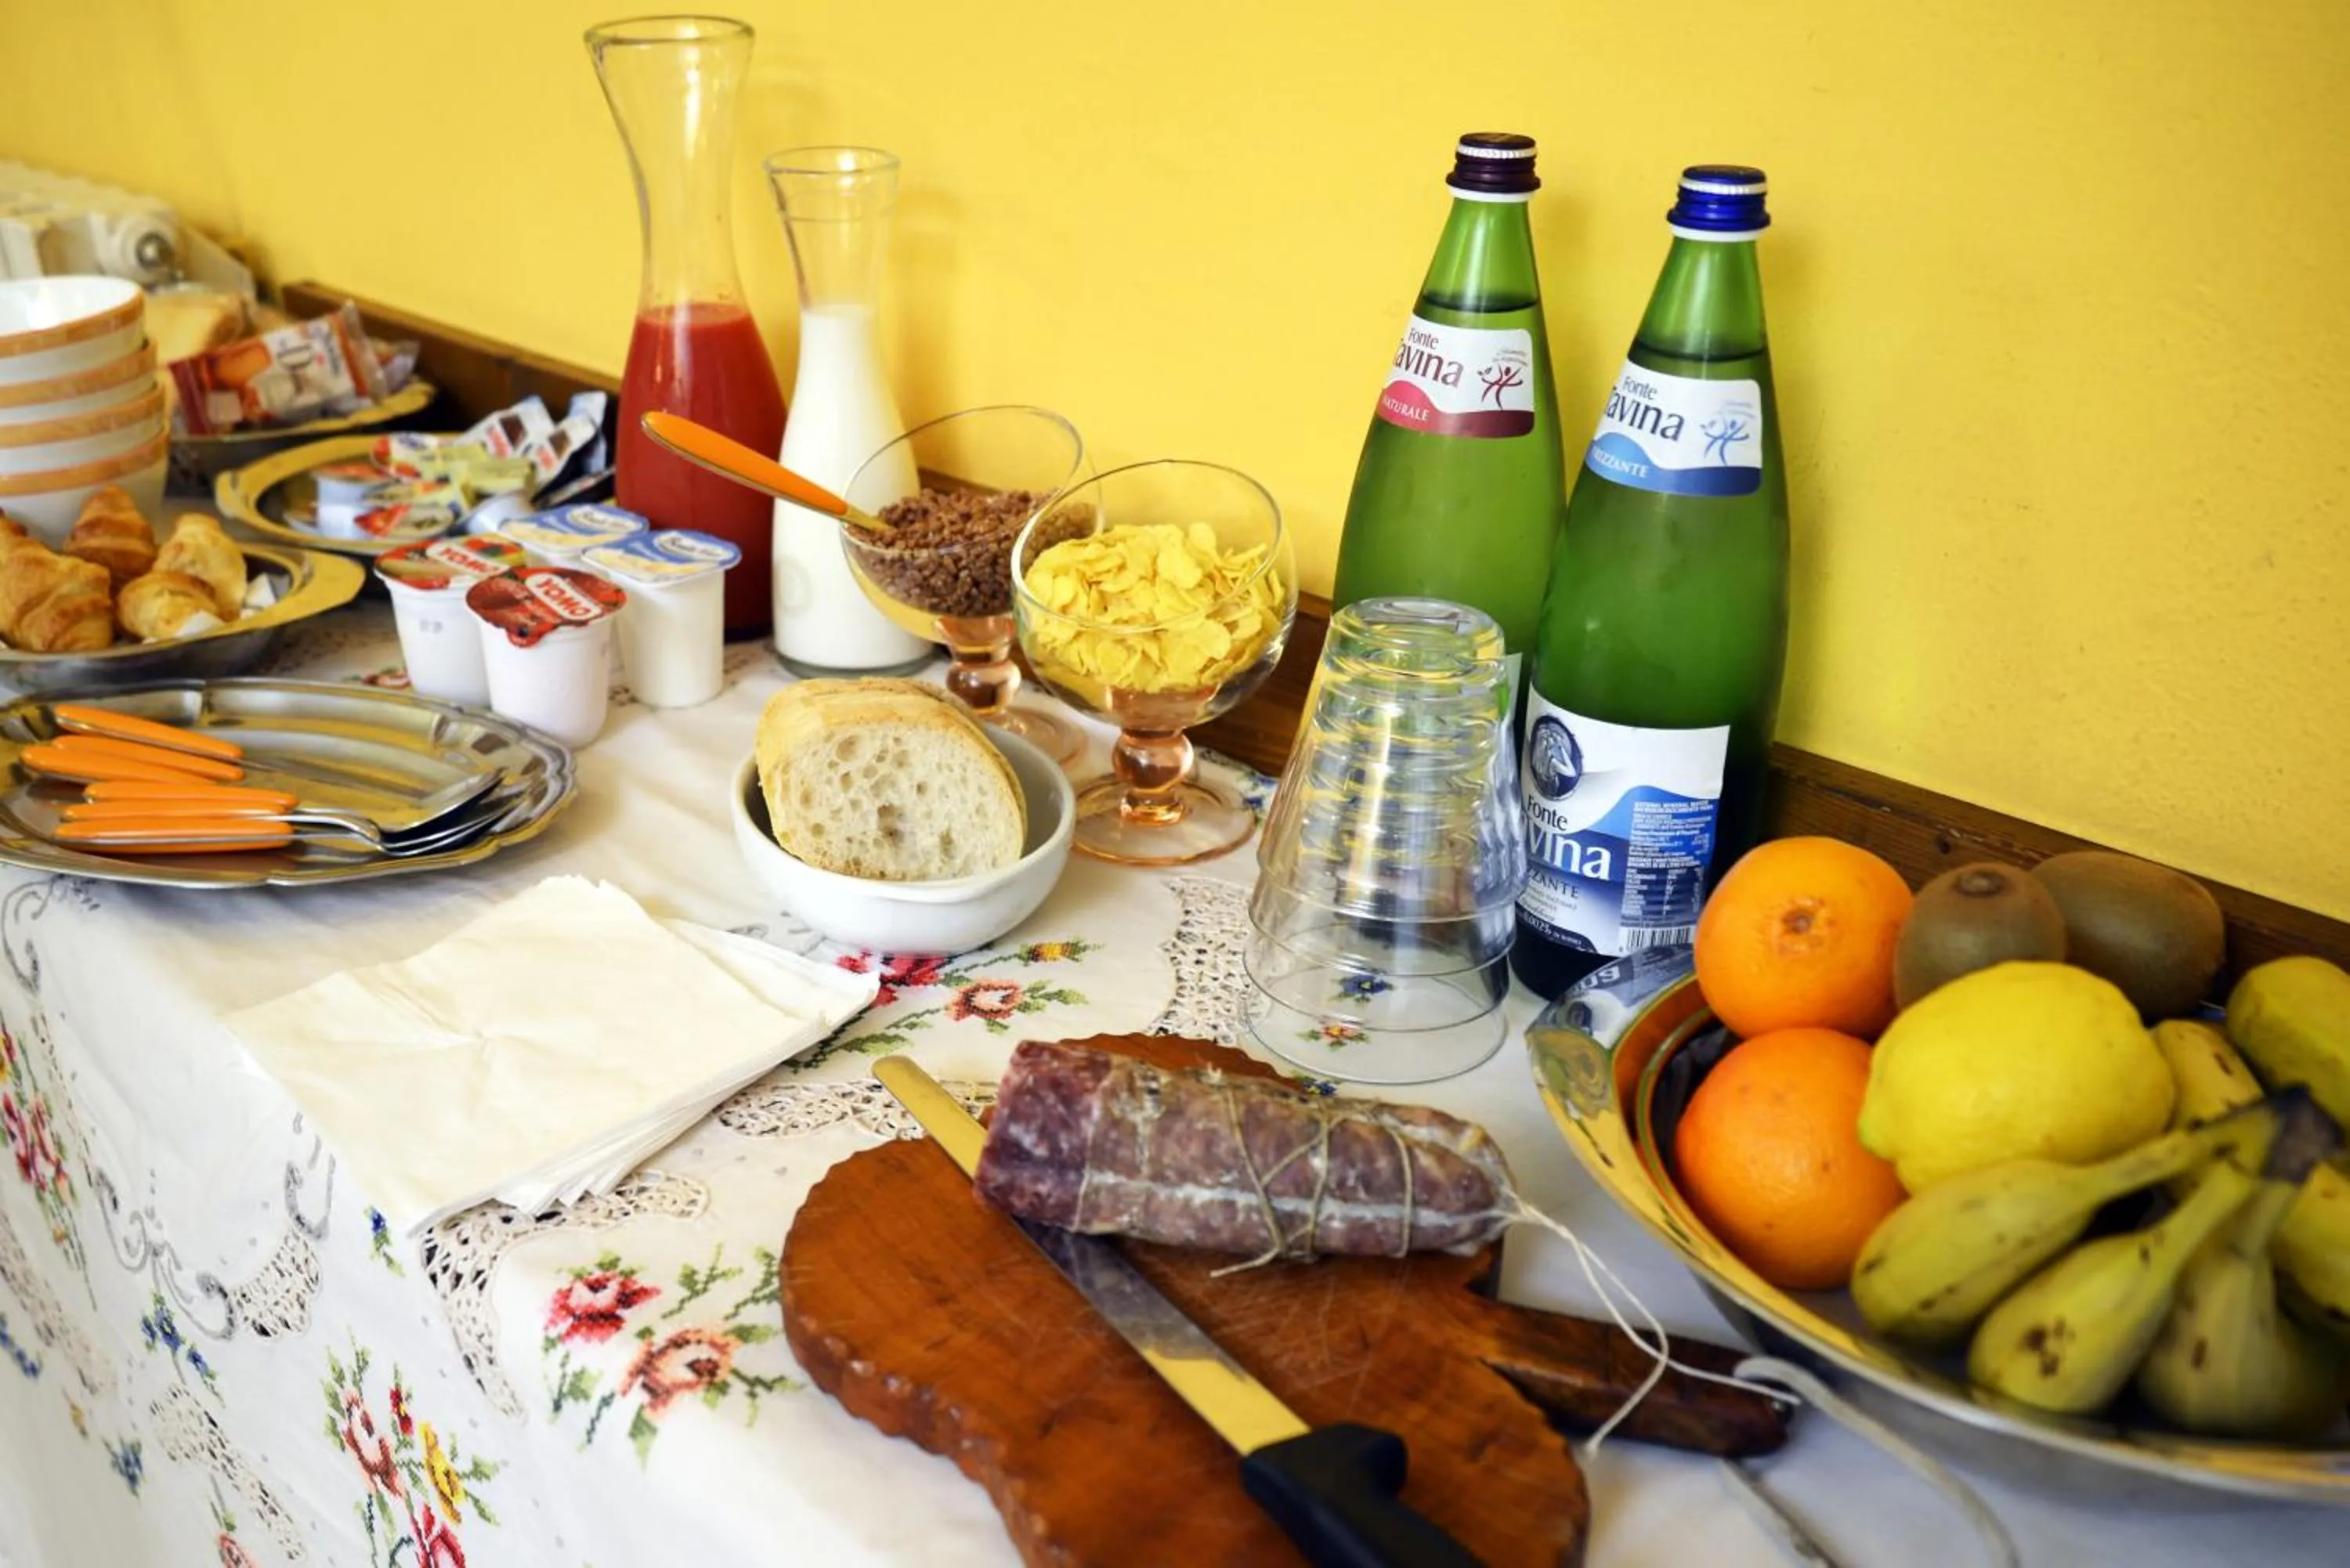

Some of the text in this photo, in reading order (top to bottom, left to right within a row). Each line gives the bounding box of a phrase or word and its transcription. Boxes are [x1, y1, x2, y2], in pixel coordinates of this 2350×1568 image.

[1409, 327, 1439, 350] Fonte
[1393, 338, 1464, 388] avina
[1623, 375, 1658, 401] Fonte
[1604, 386, 1685, 443] avina
[1592, 446, 1649, 479] IZZANTE
[1528, 793, 1568, 831] Fonte
[1527, 819, 1611, 882] vina
